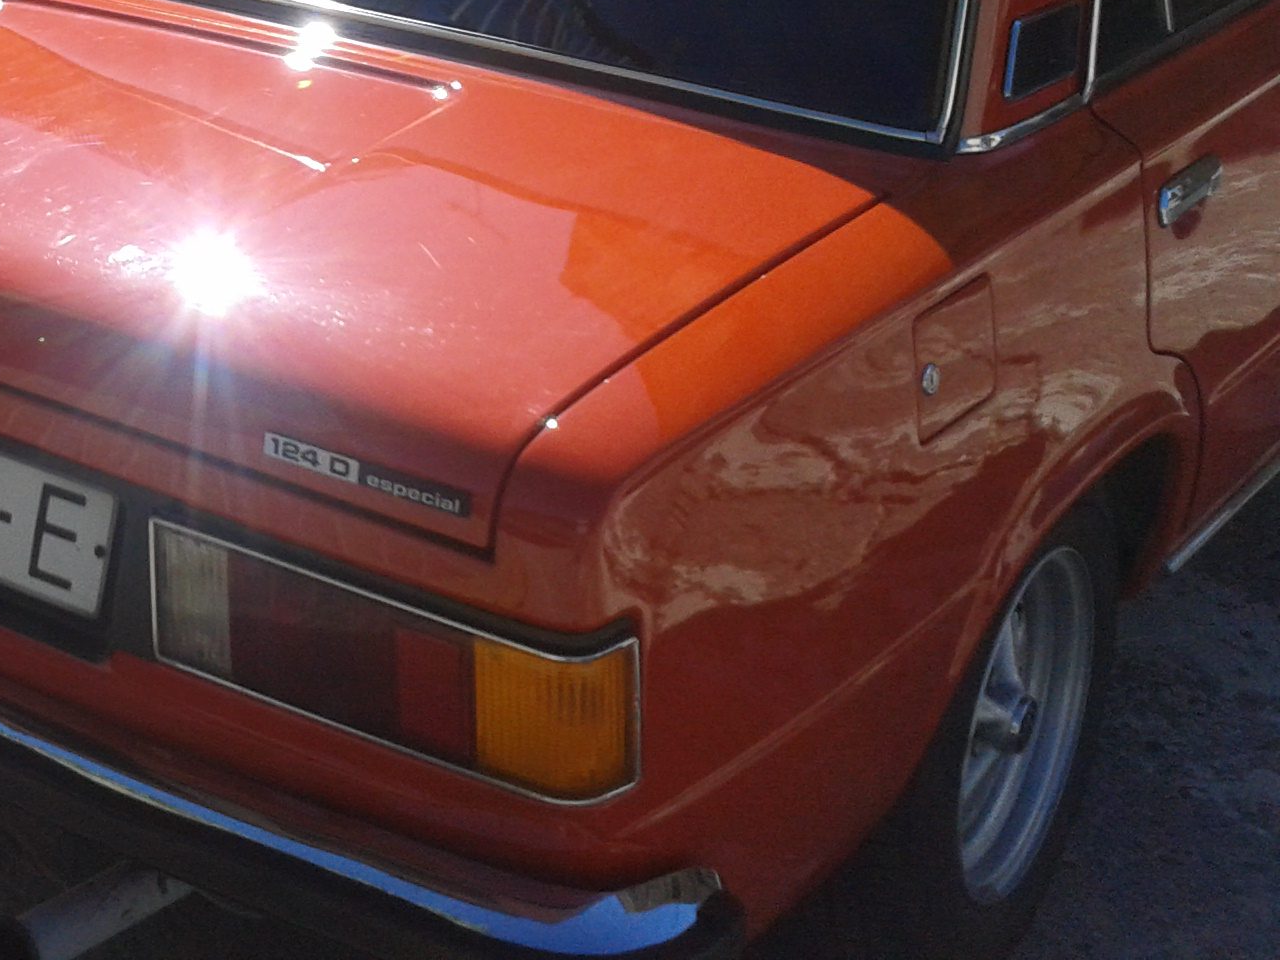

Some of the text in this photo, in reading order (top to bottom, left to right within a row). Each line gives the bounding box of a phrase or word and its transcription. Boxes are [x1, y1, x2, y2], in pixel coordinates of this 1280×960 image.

[271, 437, 461, 515] 124 D especial
